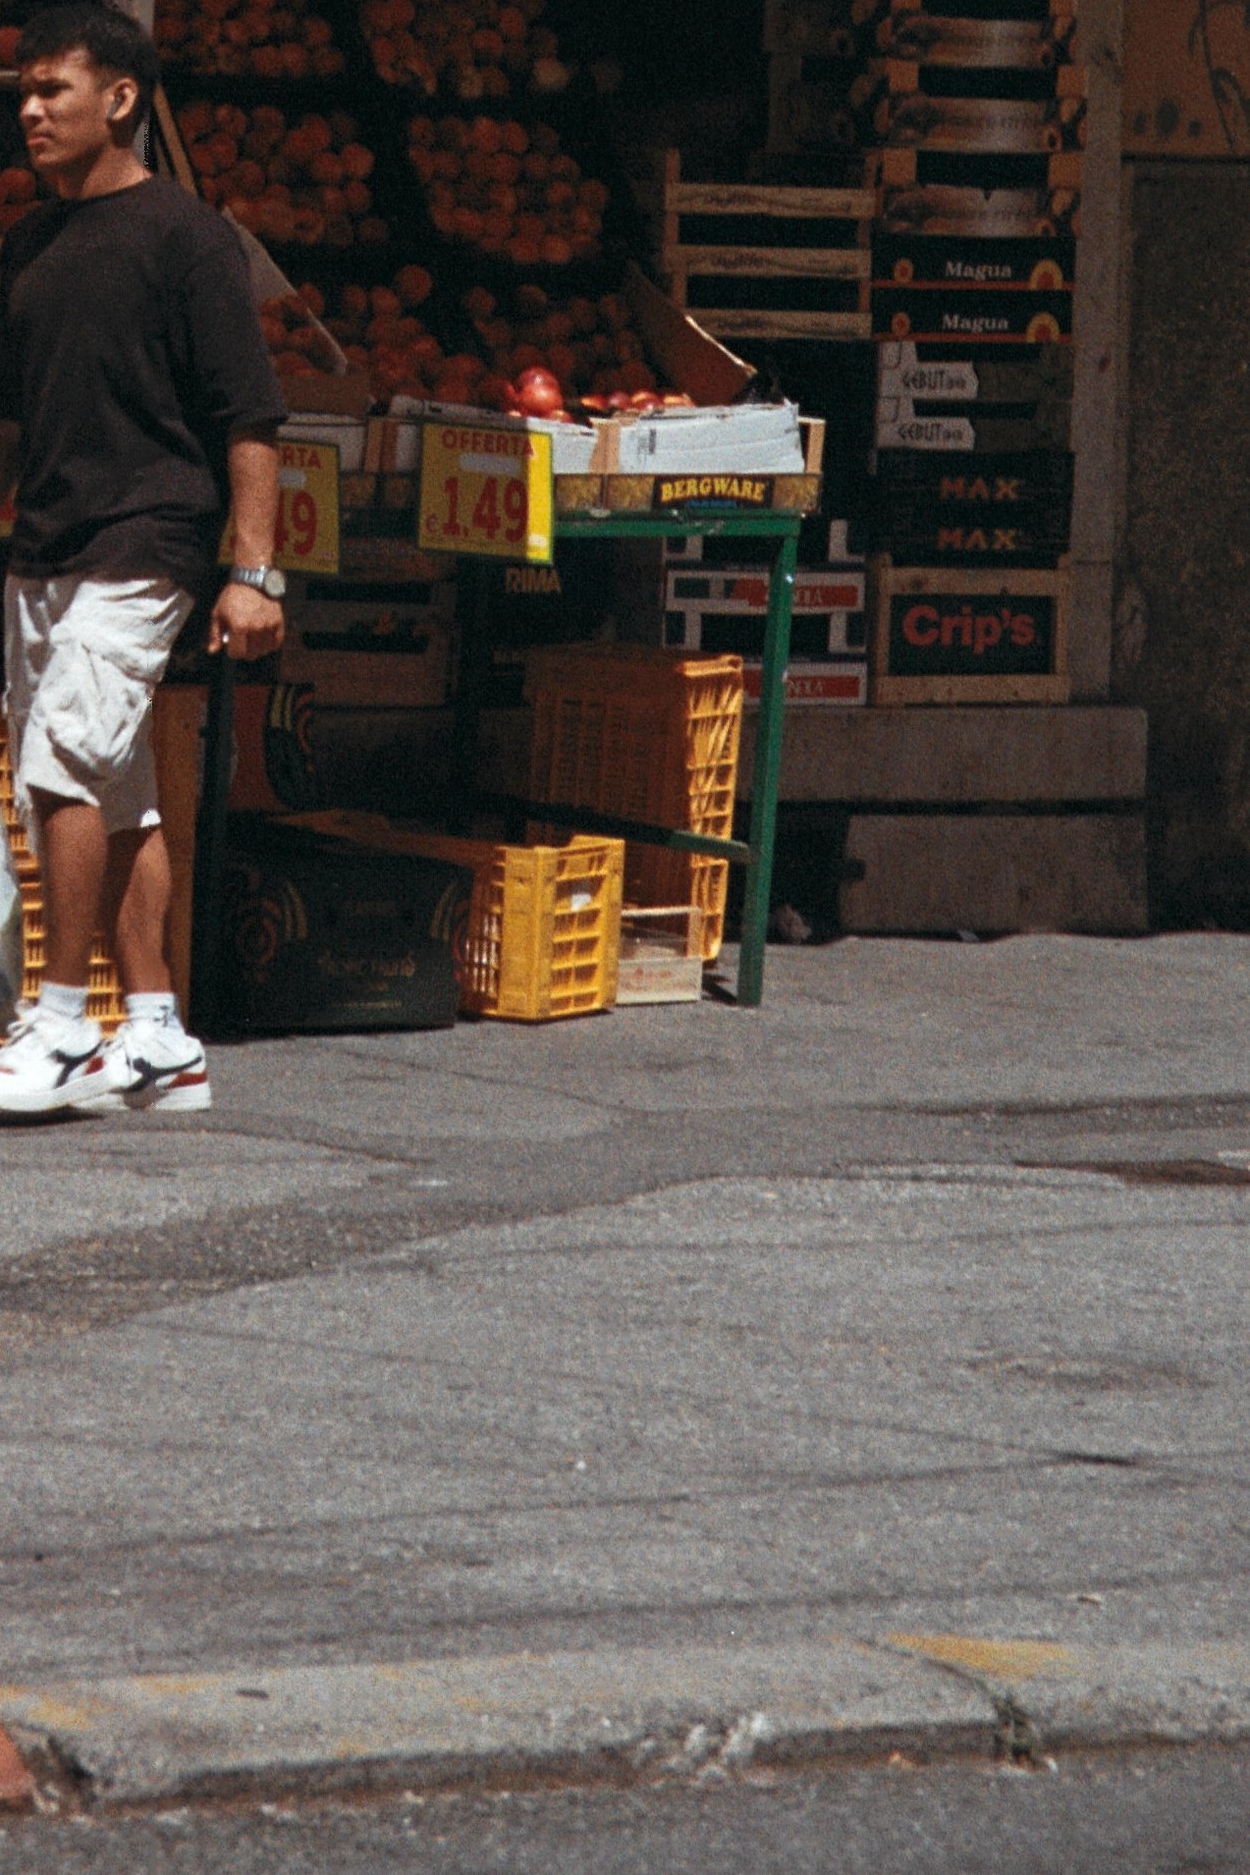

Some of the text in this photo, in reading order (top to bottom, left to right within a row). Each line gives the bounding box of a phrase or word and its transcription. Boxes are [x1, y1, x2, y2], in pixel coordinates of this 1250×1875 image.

[944, 261, 1012, 281] Magua
[941, 314, 1008, 332] Magua
[441, 429, 534, 456] OFFERTA
[660, 476, 766, 503] BERGWARE
[941, 477, 1020, 501] MAX
[937, 527, 1016, 550] MAX
[903, 604, 1035, 655] Crip's
